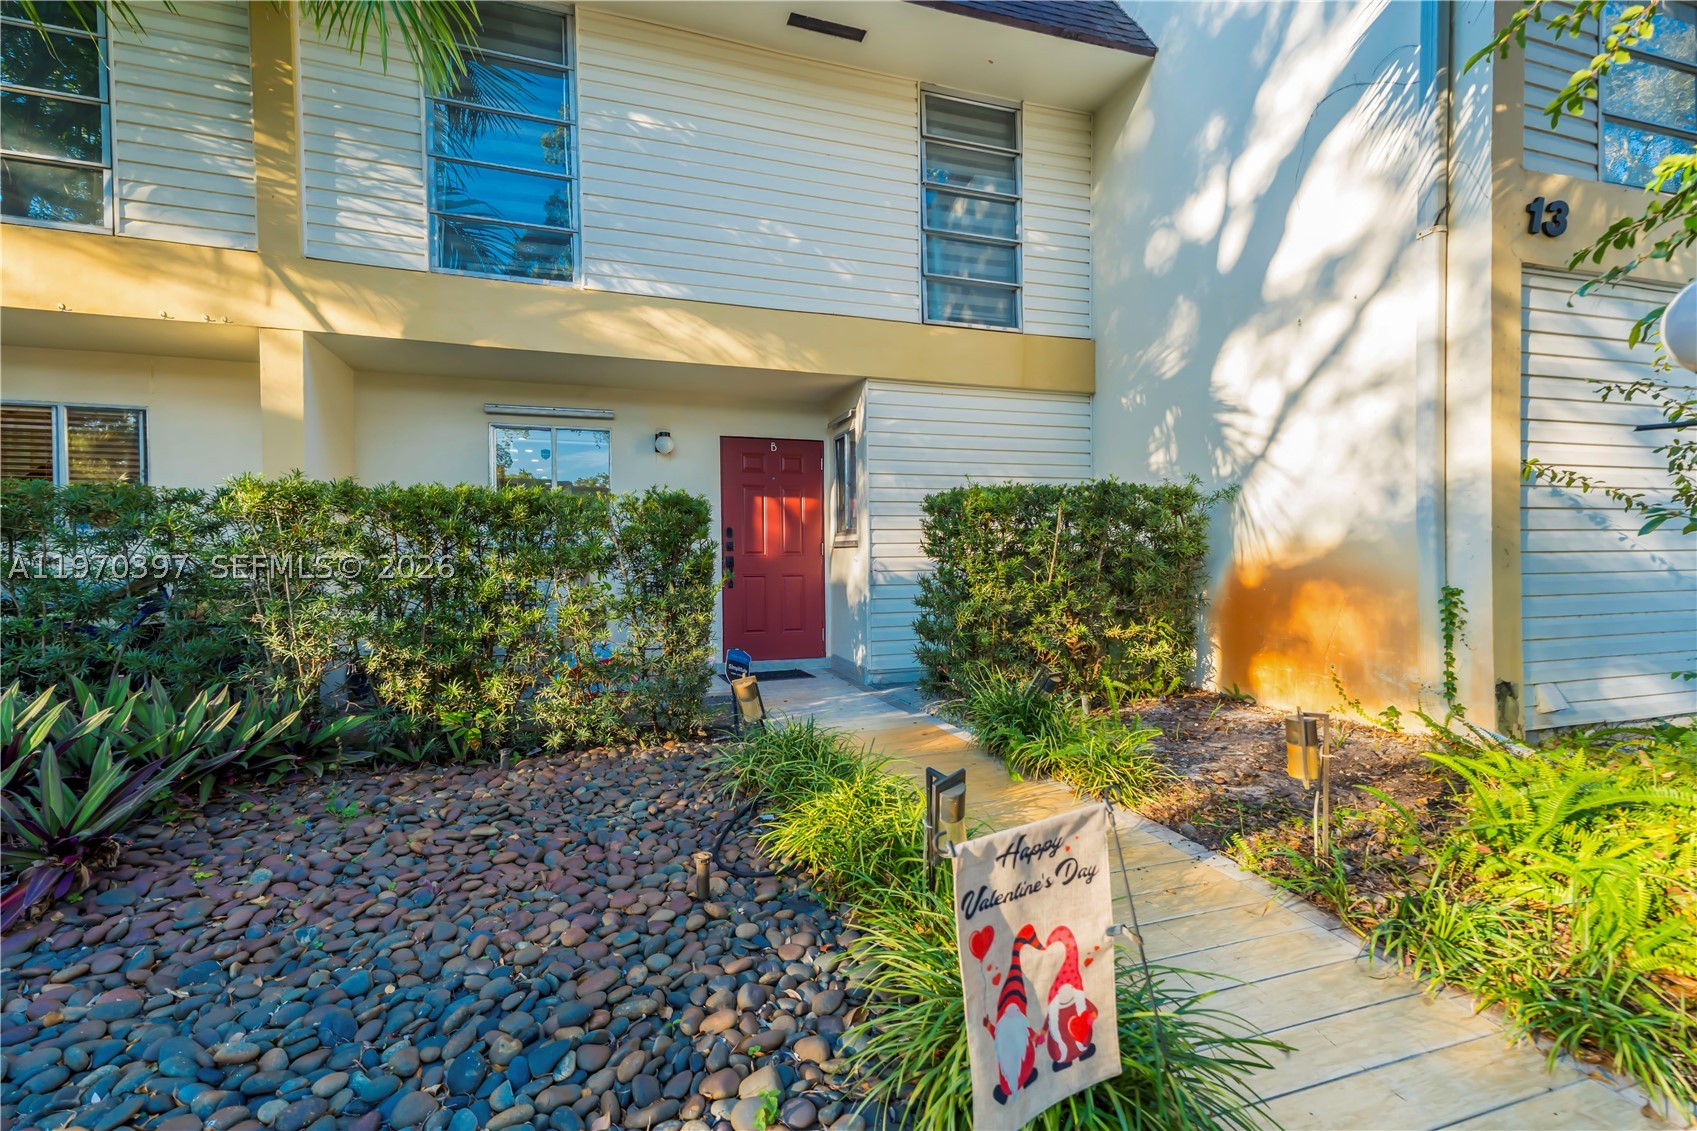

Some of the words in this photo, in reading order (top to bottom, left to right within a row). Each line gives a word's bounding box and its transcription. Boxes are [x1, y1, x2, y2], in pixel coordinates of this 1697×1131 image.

[1526, 196, 1569, 237] 13
[770, 441, 778, 452] B
[995, 833, 1064, 870] Happy
[961, 874, 1053, 920] Valentine's
[1055, 857, 1099, 886] Day
